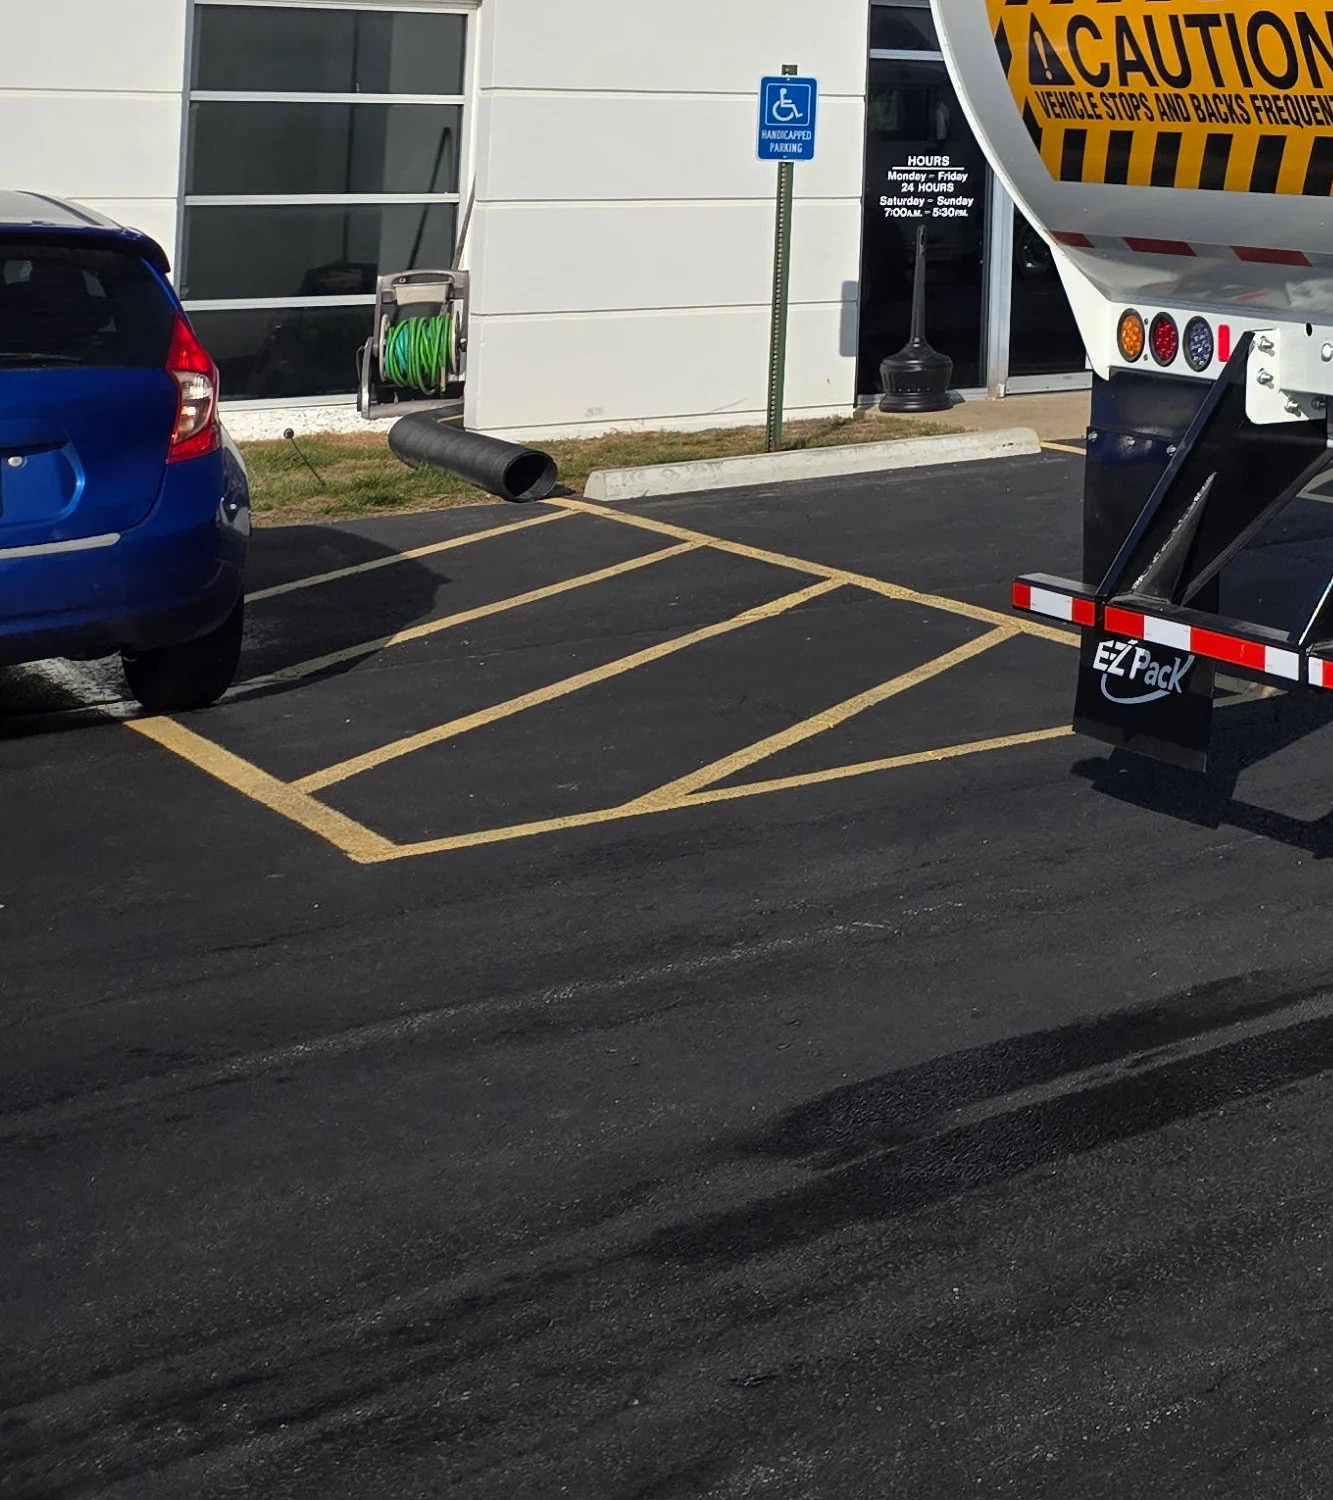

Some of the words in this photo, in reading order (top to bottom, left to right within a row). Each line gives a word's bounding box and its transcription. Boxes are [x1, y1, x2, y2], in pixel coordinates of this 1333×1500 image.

[1034, 90, 1103, 120] VEHICLE
[1100, 92, 1153, 122] STOPS
[1154, 93, 1191, 123] AND
[1191, 93, 1252, 125] BACKS
[761, 129, 812, 140] HANDICAPPED
[769, 142, 803, 153] PARKING
[907, 155, 950, 166] HOURS
[887, 171, 927, 182] Monday
[938, 171, 968, 183] Friday
[901, 182, 914, 192] 24
[918, 182, 954, 192] HOURS
[879, 195, 925, 207] Saturday
[937, 195, 974, 207] Sunday
[1129, 646, 1192, 694] Pack
